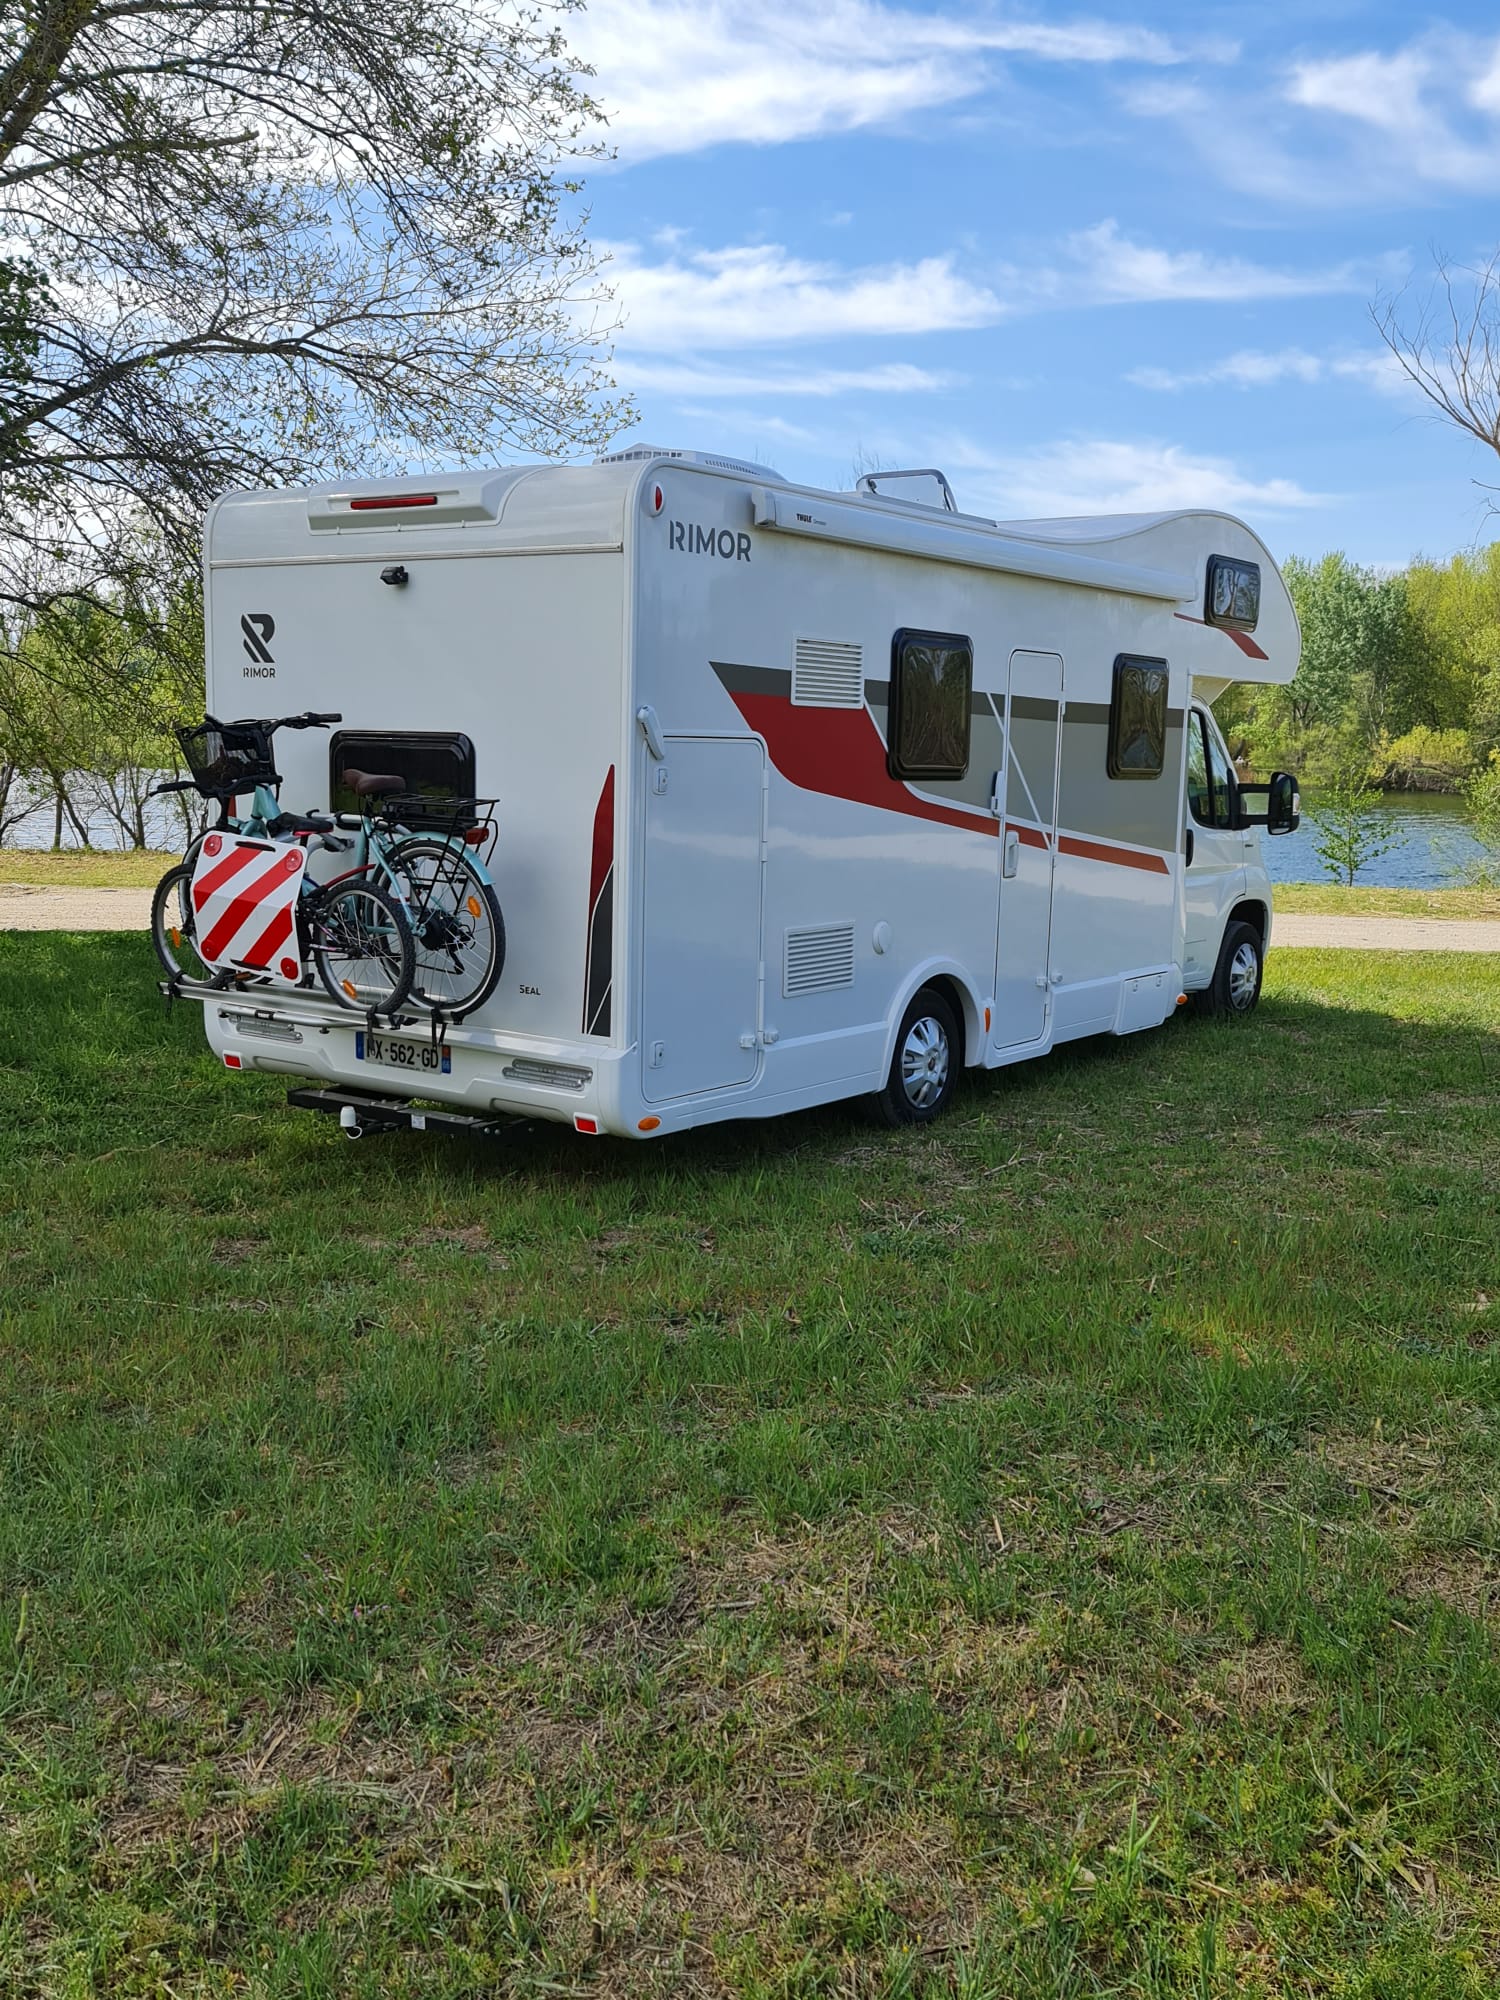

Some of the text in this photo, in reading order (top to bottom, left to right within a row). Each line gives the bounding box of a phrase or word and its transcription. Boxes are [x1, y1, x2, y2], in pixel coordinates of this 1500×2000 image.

[669, 520, 752, 562] RIMOR
[243, 667, 276, 679] RIMOR
[519, 984, 542, 996] SEAL
